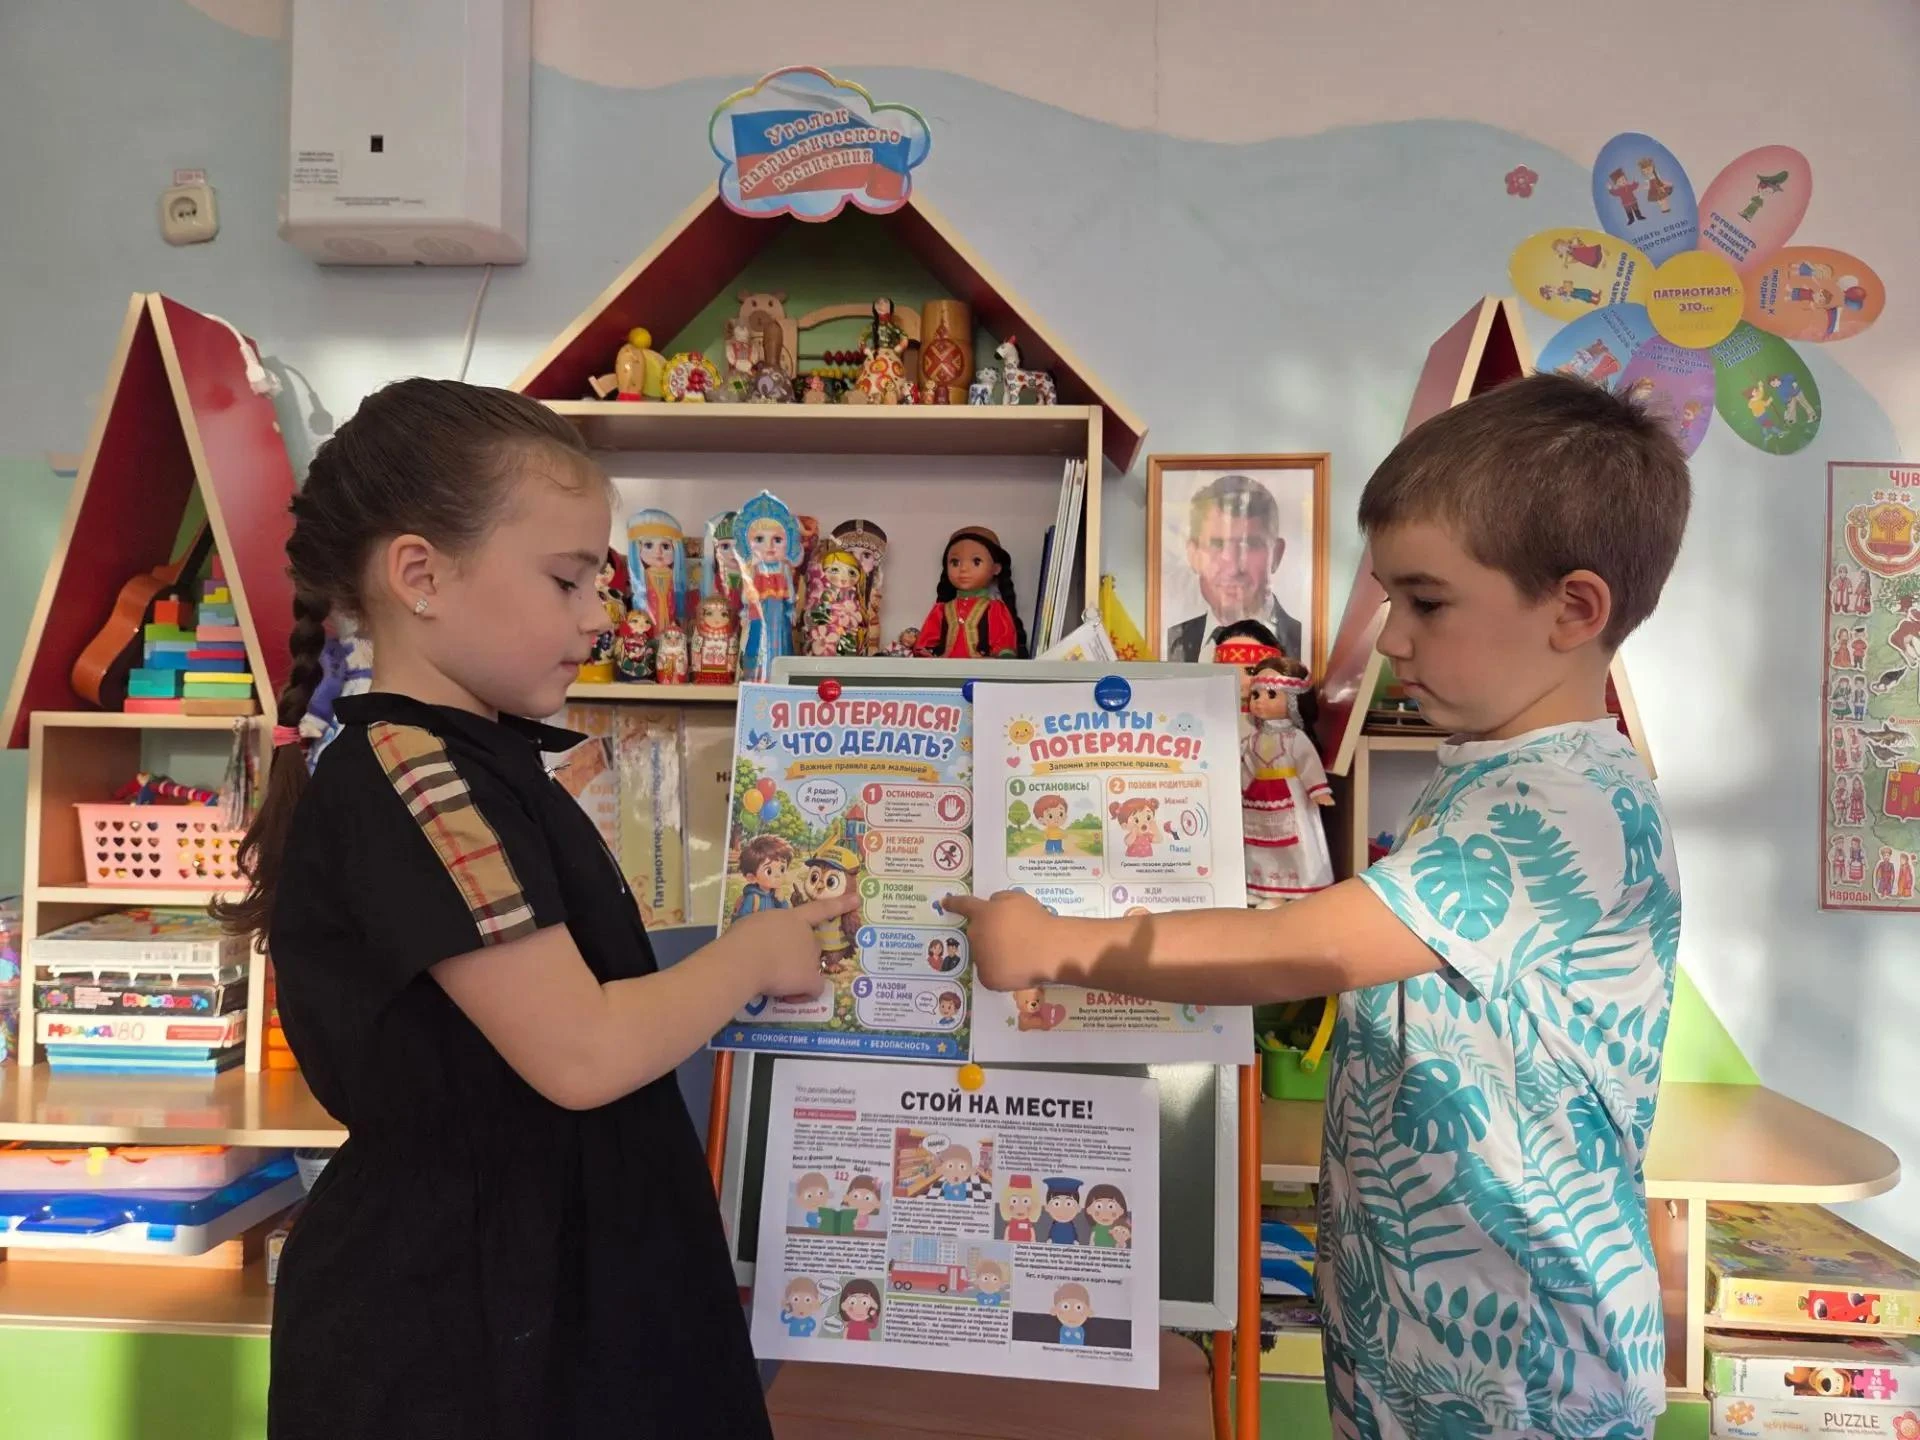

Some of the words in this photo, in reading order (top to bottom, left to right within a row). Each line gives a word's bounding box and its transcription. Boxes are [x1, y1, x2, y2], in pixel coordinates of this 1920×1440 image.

[766, 109, 850, 145] Уголок
[1653, 286, 1731, 300] ПАТРИОТИЗМ
[771, 703, 789, 728] Я
[799, 701, 961, 732] ПОТЕРЯЛСЯ!
[1044, 712, 1111, 734] ЕСЛИ
[1115, 711, 1153, 730] ТЫ
[782, 731, 833, 755] ЧТО
[840, 731, 954, 759] ДЕЛАТЬ?
[1029, 733, 1201, 762] ПОТЕРЯЛСЯ!
[799, 761, 833, 771] Важные
[835, 763, 868, 772] правила
[870, 764, 886, 773] для
[888, 765, 929, 774] малышей
[1049, 761, 1084, 771] Запомни
[1101, 760, 1133, 769] простые
[1136, 760, 1171, 769] правила.
[1029, 782, 1090, 793] ОСТАНОВИСЬ!
[1128, 781, 1157, 790] ПОЗОВИ
[868, 787, 876, 801] 1
[885, 790, 935, 799] ОСТАНОВИСЬ
[886, 836, 897, 844] НЕ
[882, 892, 893, 900] НА
[861, 931, 872, 945] 4
[880, 932, 916, 940] ОБРАТИСЬ
[858, 980, 867, 994] 5
[876, 982, 907, 990] НАЗОВИ
[752, 1033, 808, 1044] СПОКОЙСТВИЕ
[817, 1037, 860, 1046] ВНИМАНИЕ
[870, 1040, 930, 1050] БЕЗОПАСНОСТЬ
[900, 1088, 962, 1113] СТОЙ
[969, 1094, 999, 1115] НА
[1005, 1097, 1093, 1120] МЕСТЕ!
[1824, 1412, 1880, 1429] PUZZLE
